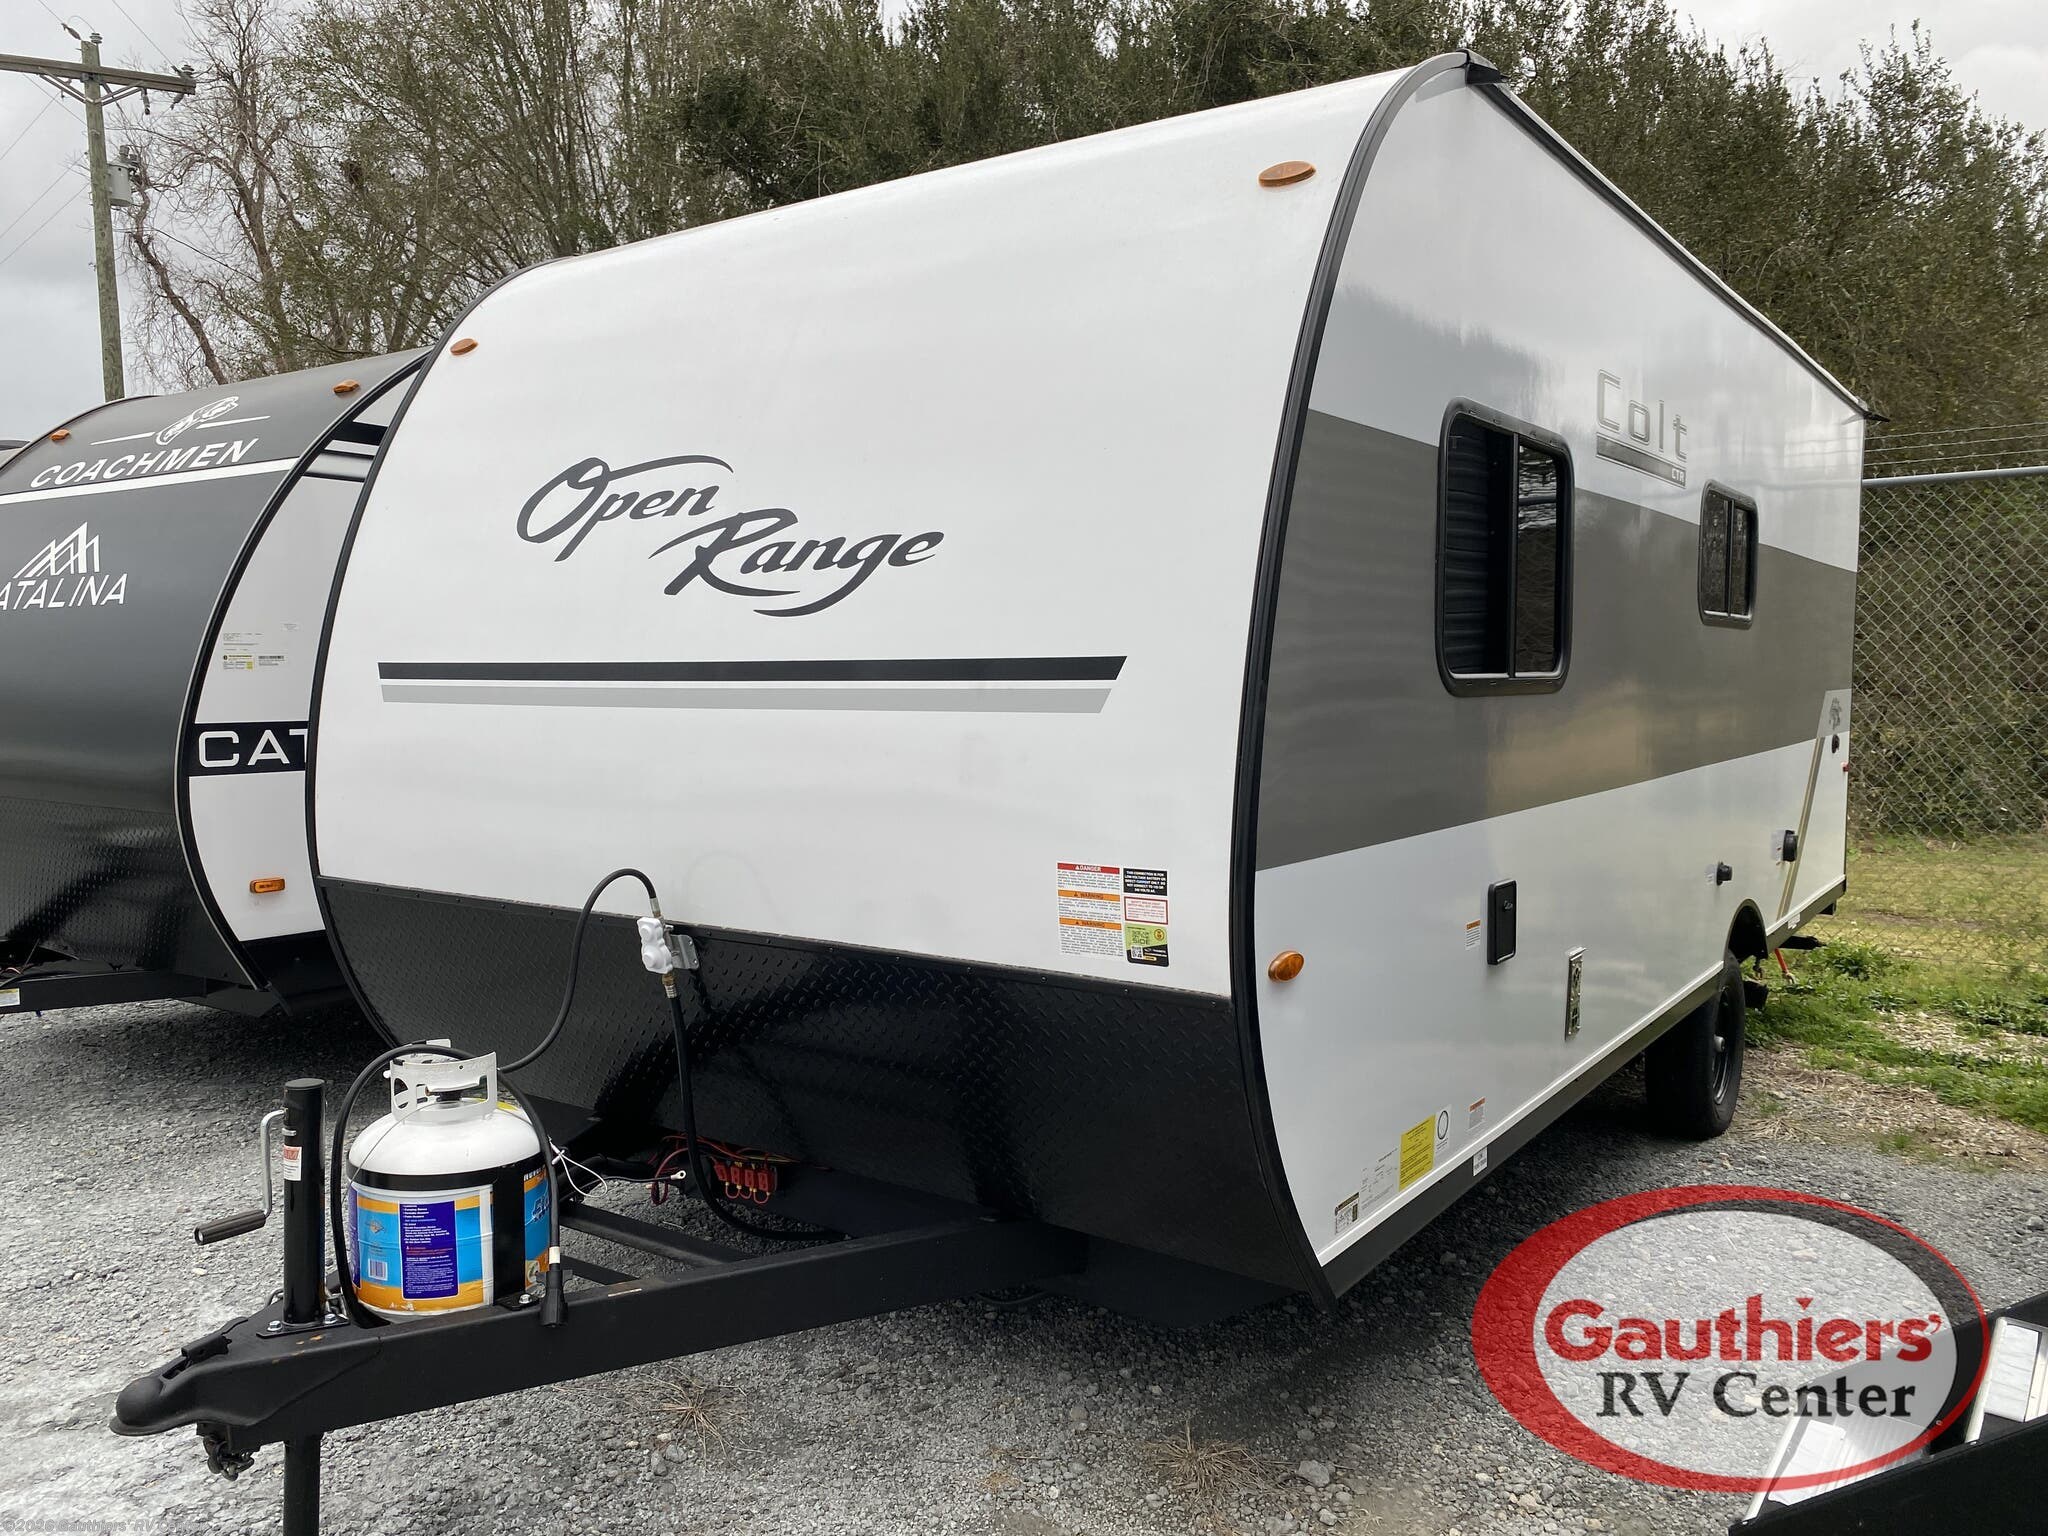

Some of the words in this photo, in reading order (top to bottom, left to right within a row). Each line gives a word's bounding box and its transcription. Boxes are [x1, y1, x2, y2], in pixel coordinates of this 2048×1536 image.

[1597, 368, 1688, 462] Colt
[30, 438, 260, 488] COACHMEN
[516, 454, 734, 562] Open
[648, 508, 945, 618] Range
